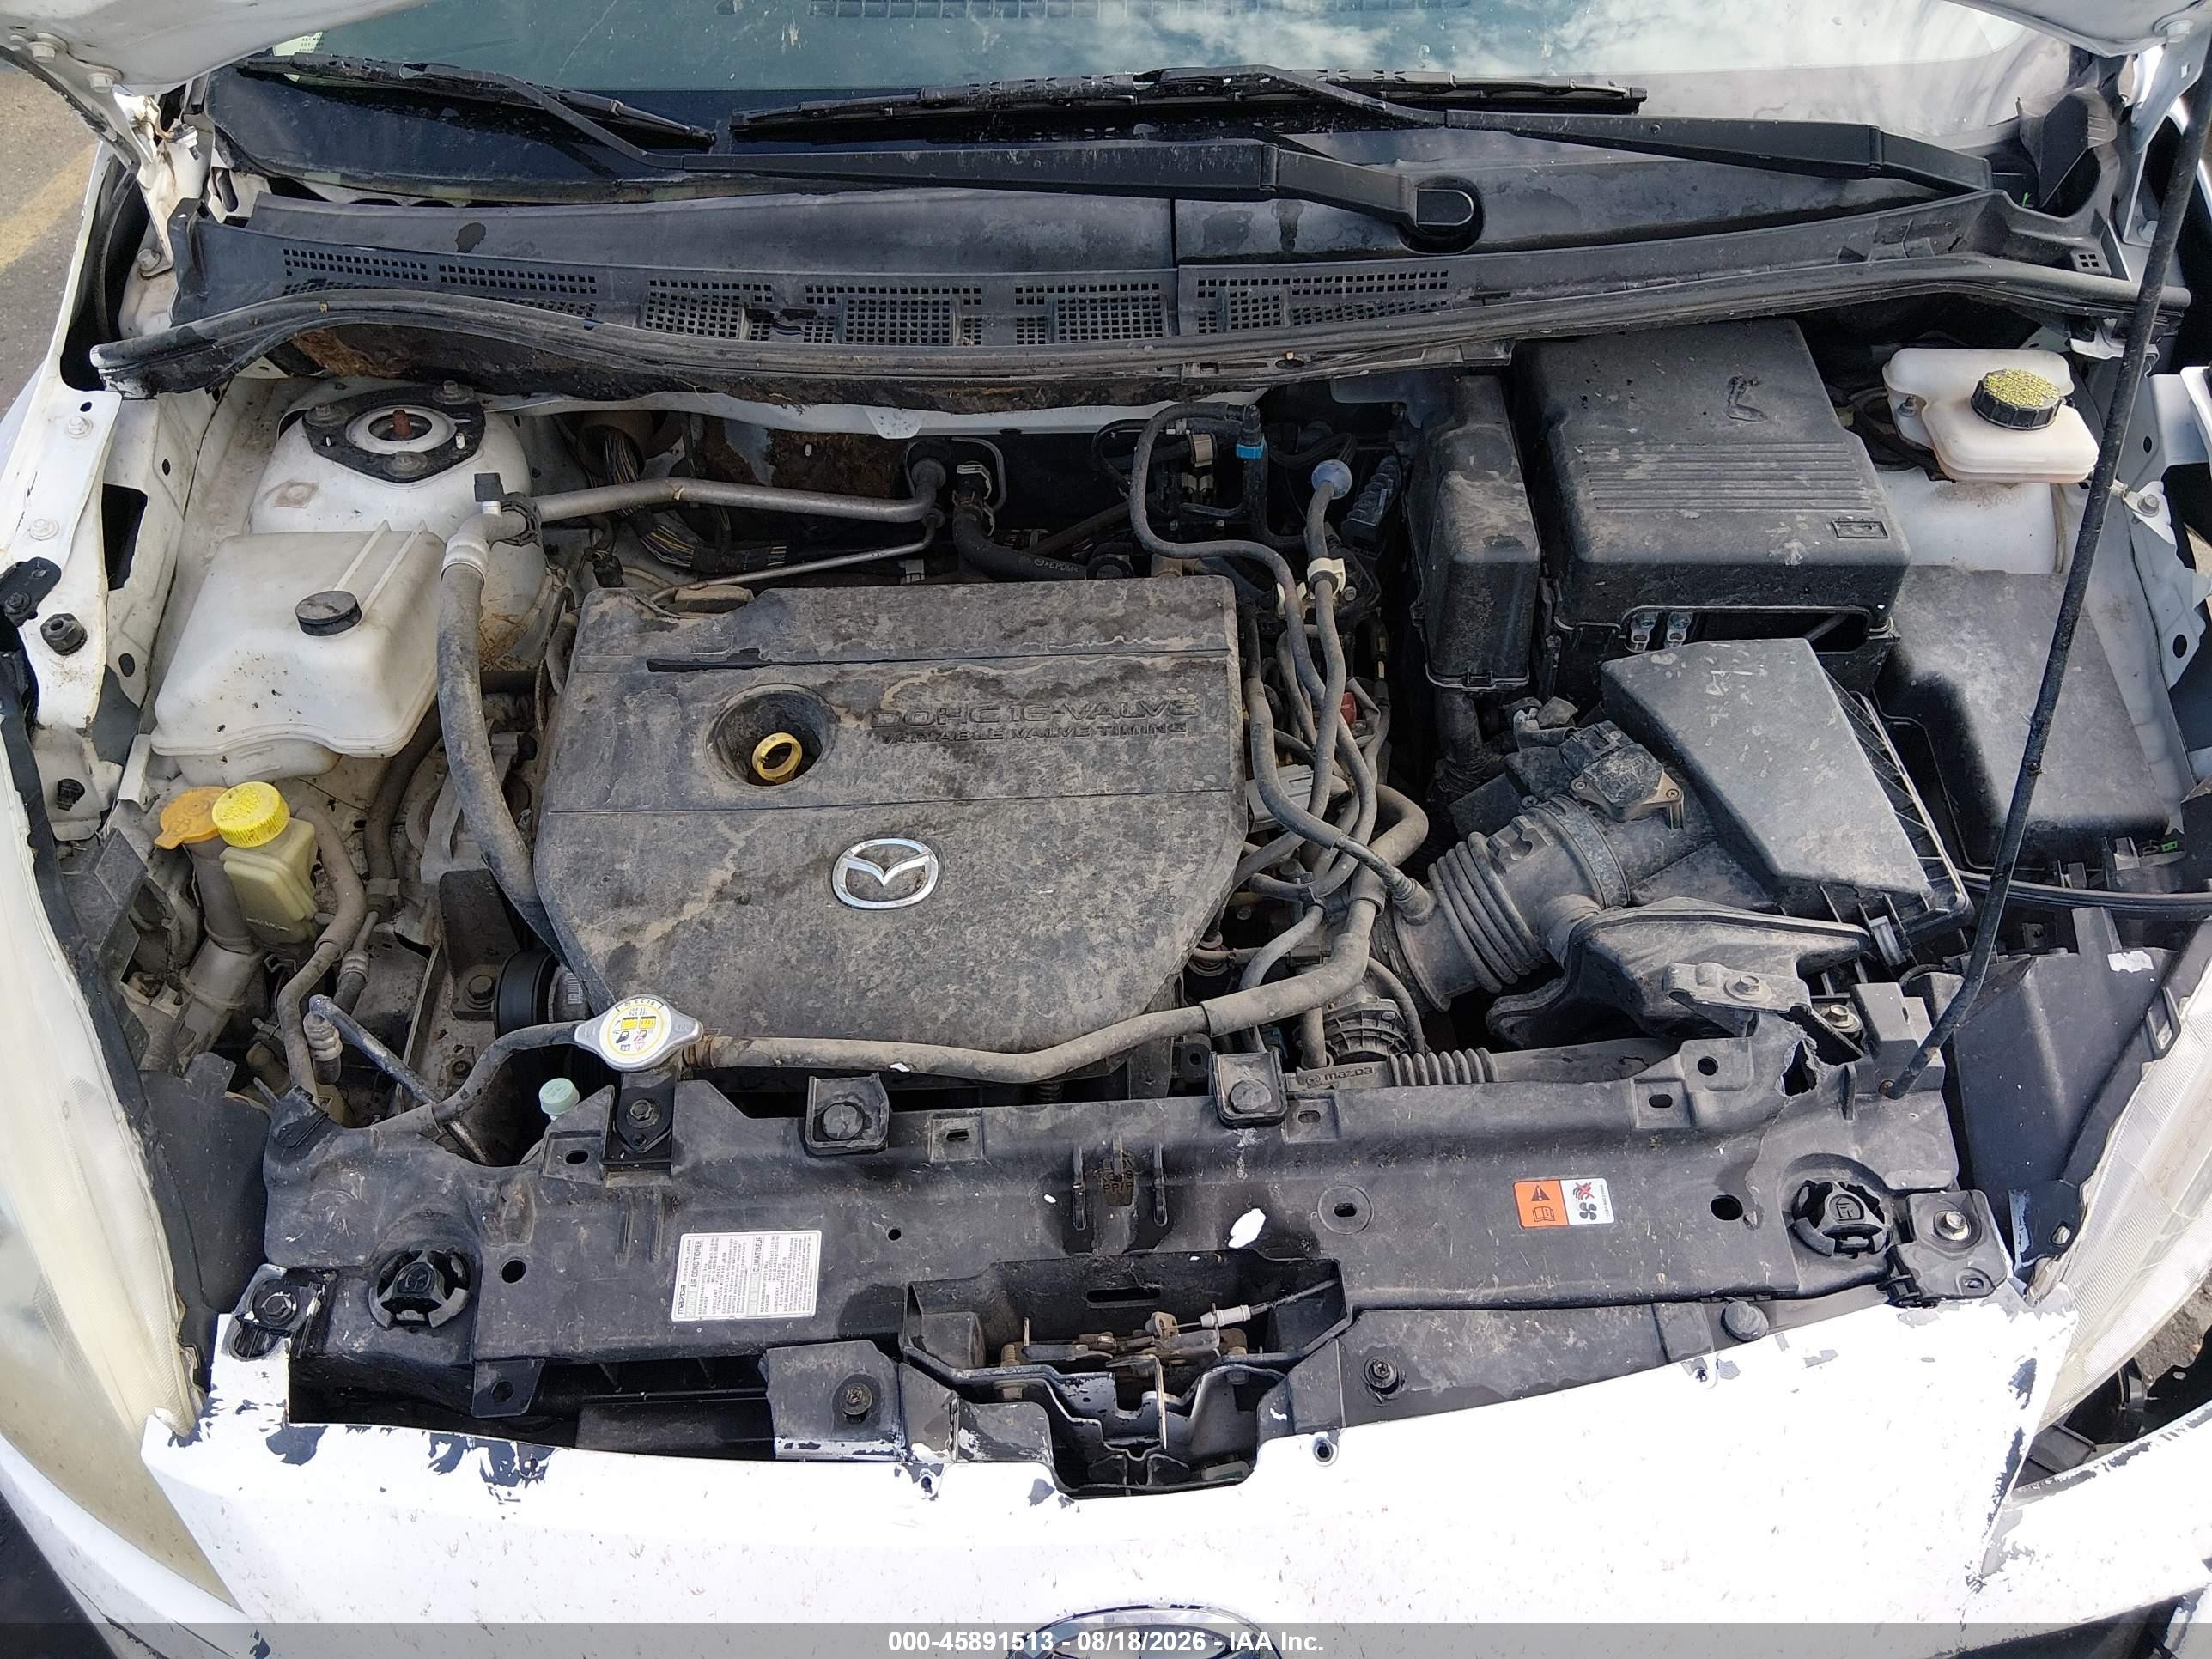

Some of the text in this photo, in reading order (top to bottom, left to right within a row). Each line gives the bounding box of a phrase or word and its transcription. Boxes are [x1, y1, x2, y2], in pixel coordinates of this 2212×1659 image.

[871, 704, 1000, 729] DOHC
[883, 722, 1188, 744] VARIABLE VALVE TIMING
[1323, 1066, 1375, 1081] mazda
[690, 1240, 702, 1278] CONDITIONER
[752, 1236, 763, 1273] CLIMATISEUR
[678, 1284, 686, 1315] mazda
